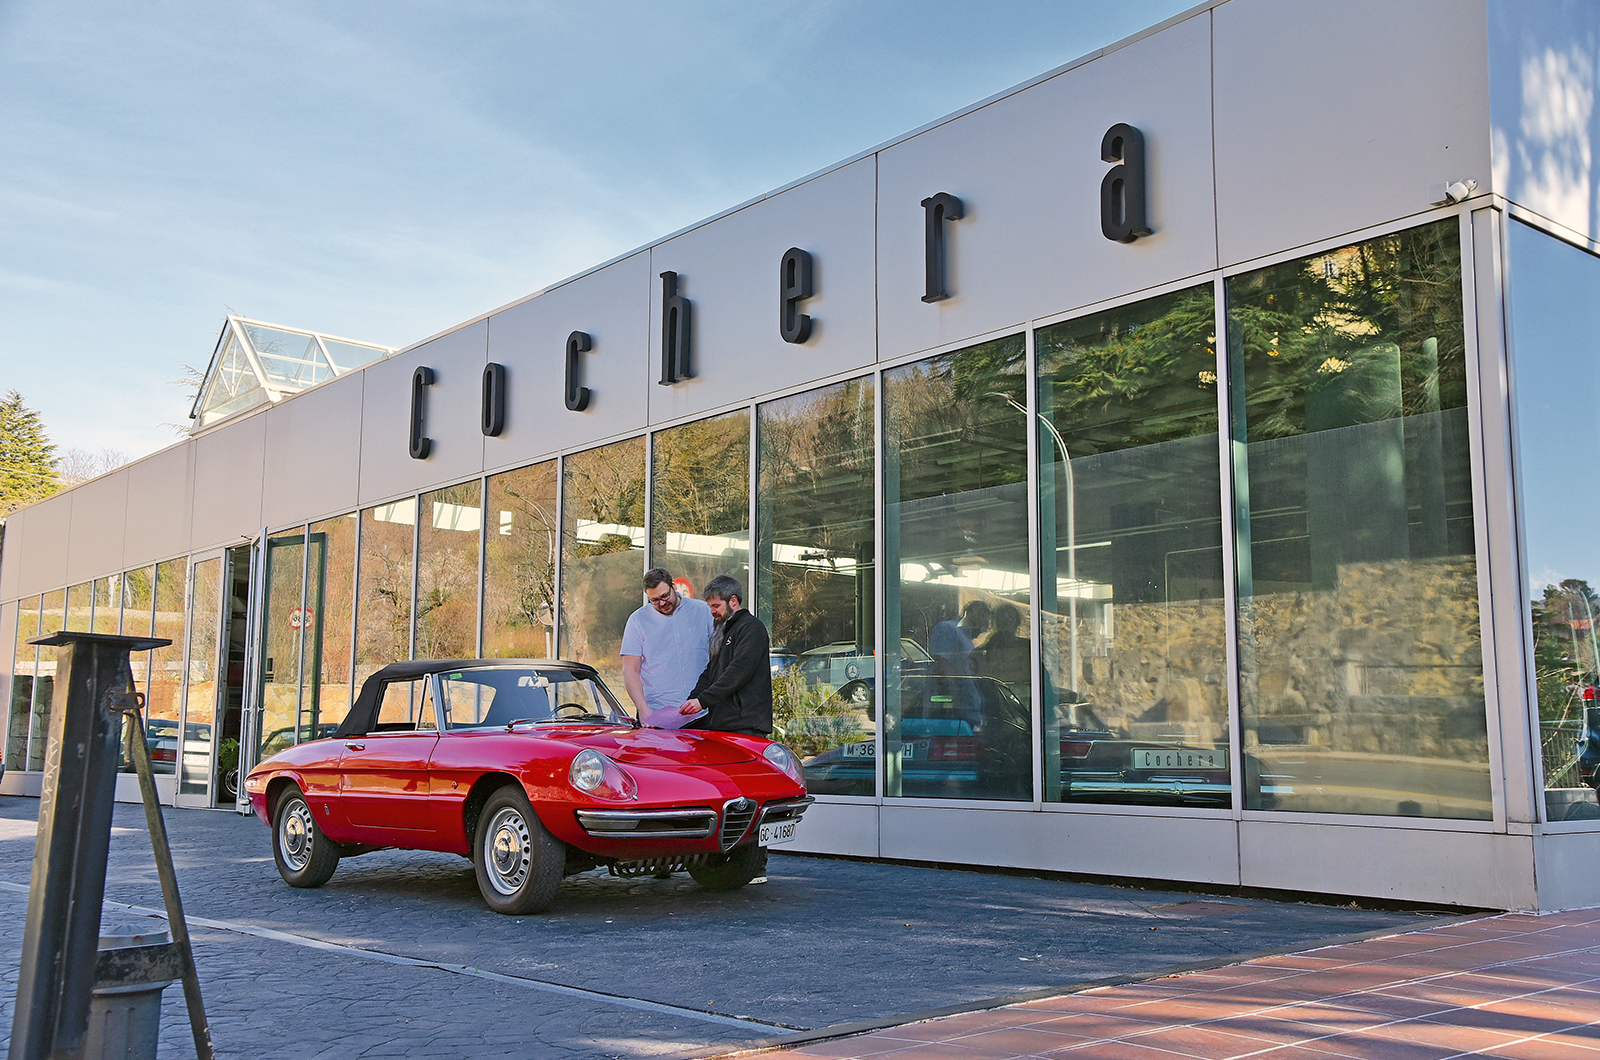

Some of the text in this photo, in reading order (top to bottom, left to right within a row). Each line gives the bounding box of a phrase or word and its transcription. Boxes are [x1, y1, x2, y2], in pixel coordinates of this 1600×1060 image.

[408, 122, 1153, 460] Cochera
[1145, 751, 1215, 767] Cochera
[759, 823, 796, 842] GC-41687
